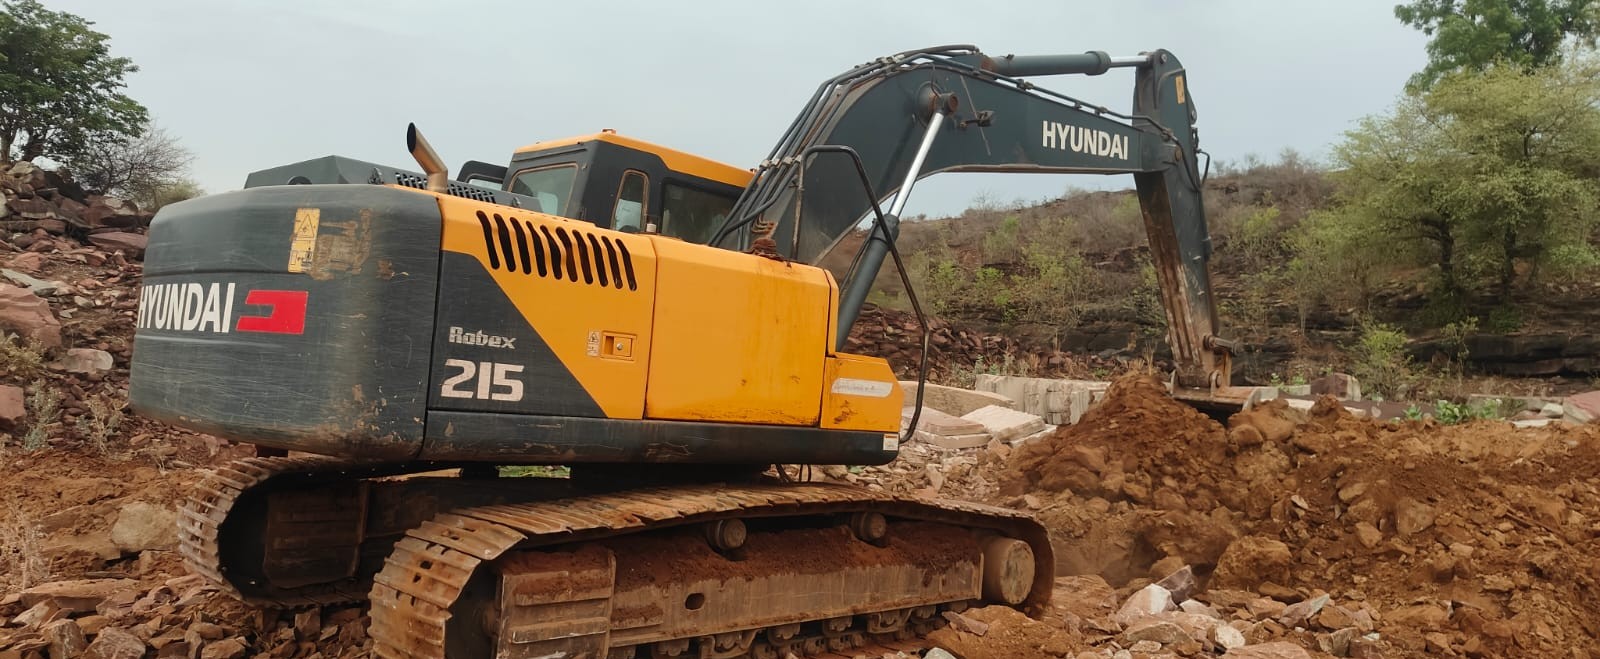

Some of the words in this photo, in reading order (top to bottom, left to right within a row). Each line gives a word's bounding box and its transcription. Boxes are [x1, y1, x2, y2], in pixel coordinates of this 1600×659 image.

[1042, 120, 1129, 160] HYUNDAI
[136, 282, 236, 333] HYUNDAI
[449, 326, 517, 349] Robex
[441, 358, 525, 402] 215
